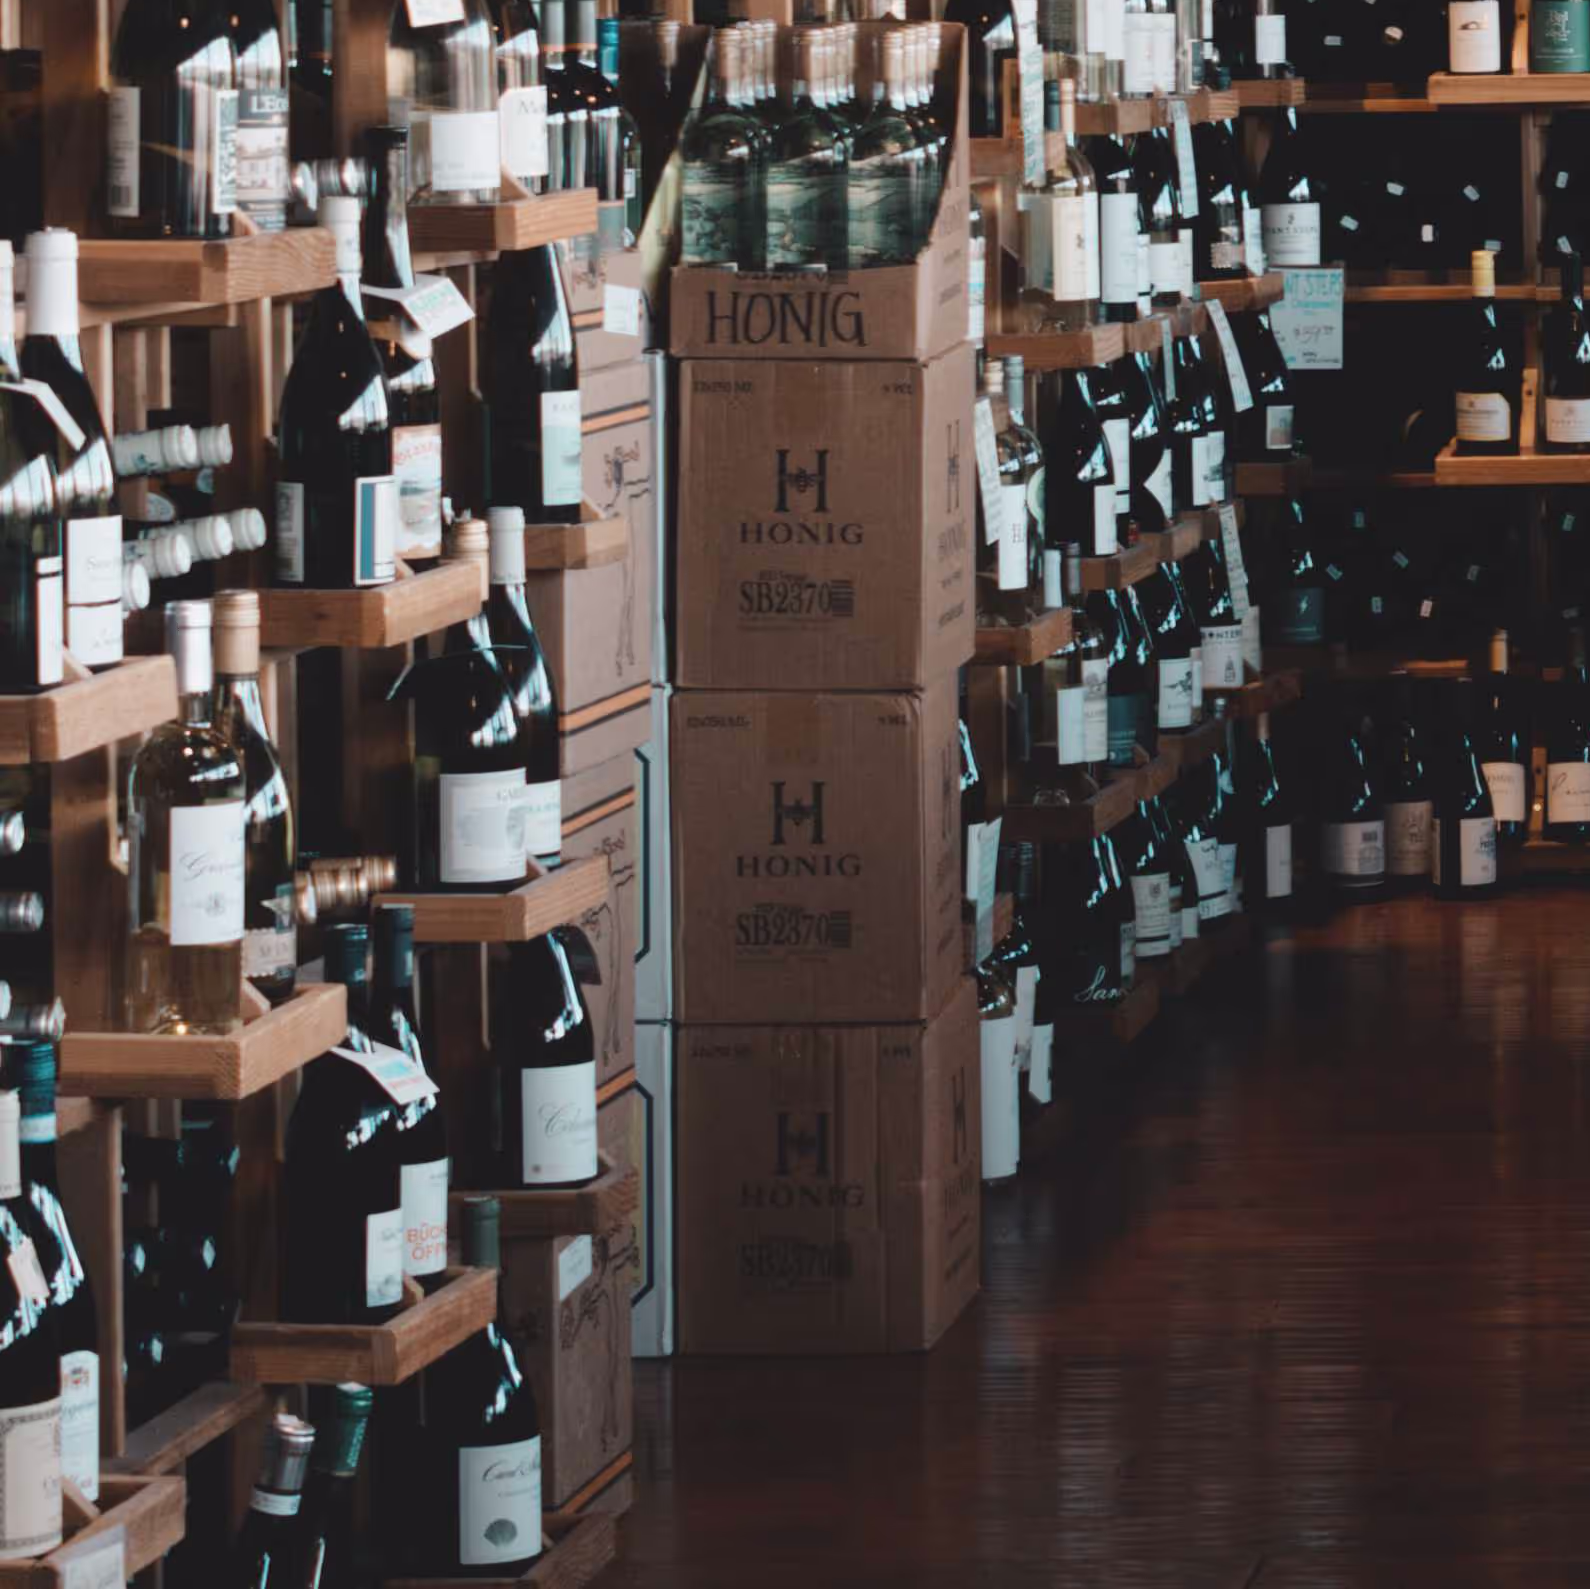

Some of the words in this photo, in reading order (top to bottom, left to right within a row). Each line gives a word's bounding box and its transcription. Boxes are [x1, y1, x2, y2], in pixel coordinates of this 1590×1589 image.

[705, 290, 867, 347] HONIG
[740, 521, 865, 545] HONIG
[738, 580, 833, 615] SB2370
[736, 854, 862, 878] HONIG
[736, 913, 832, 946] SB2370
[740, 1182, 865, 1209] HONIG
